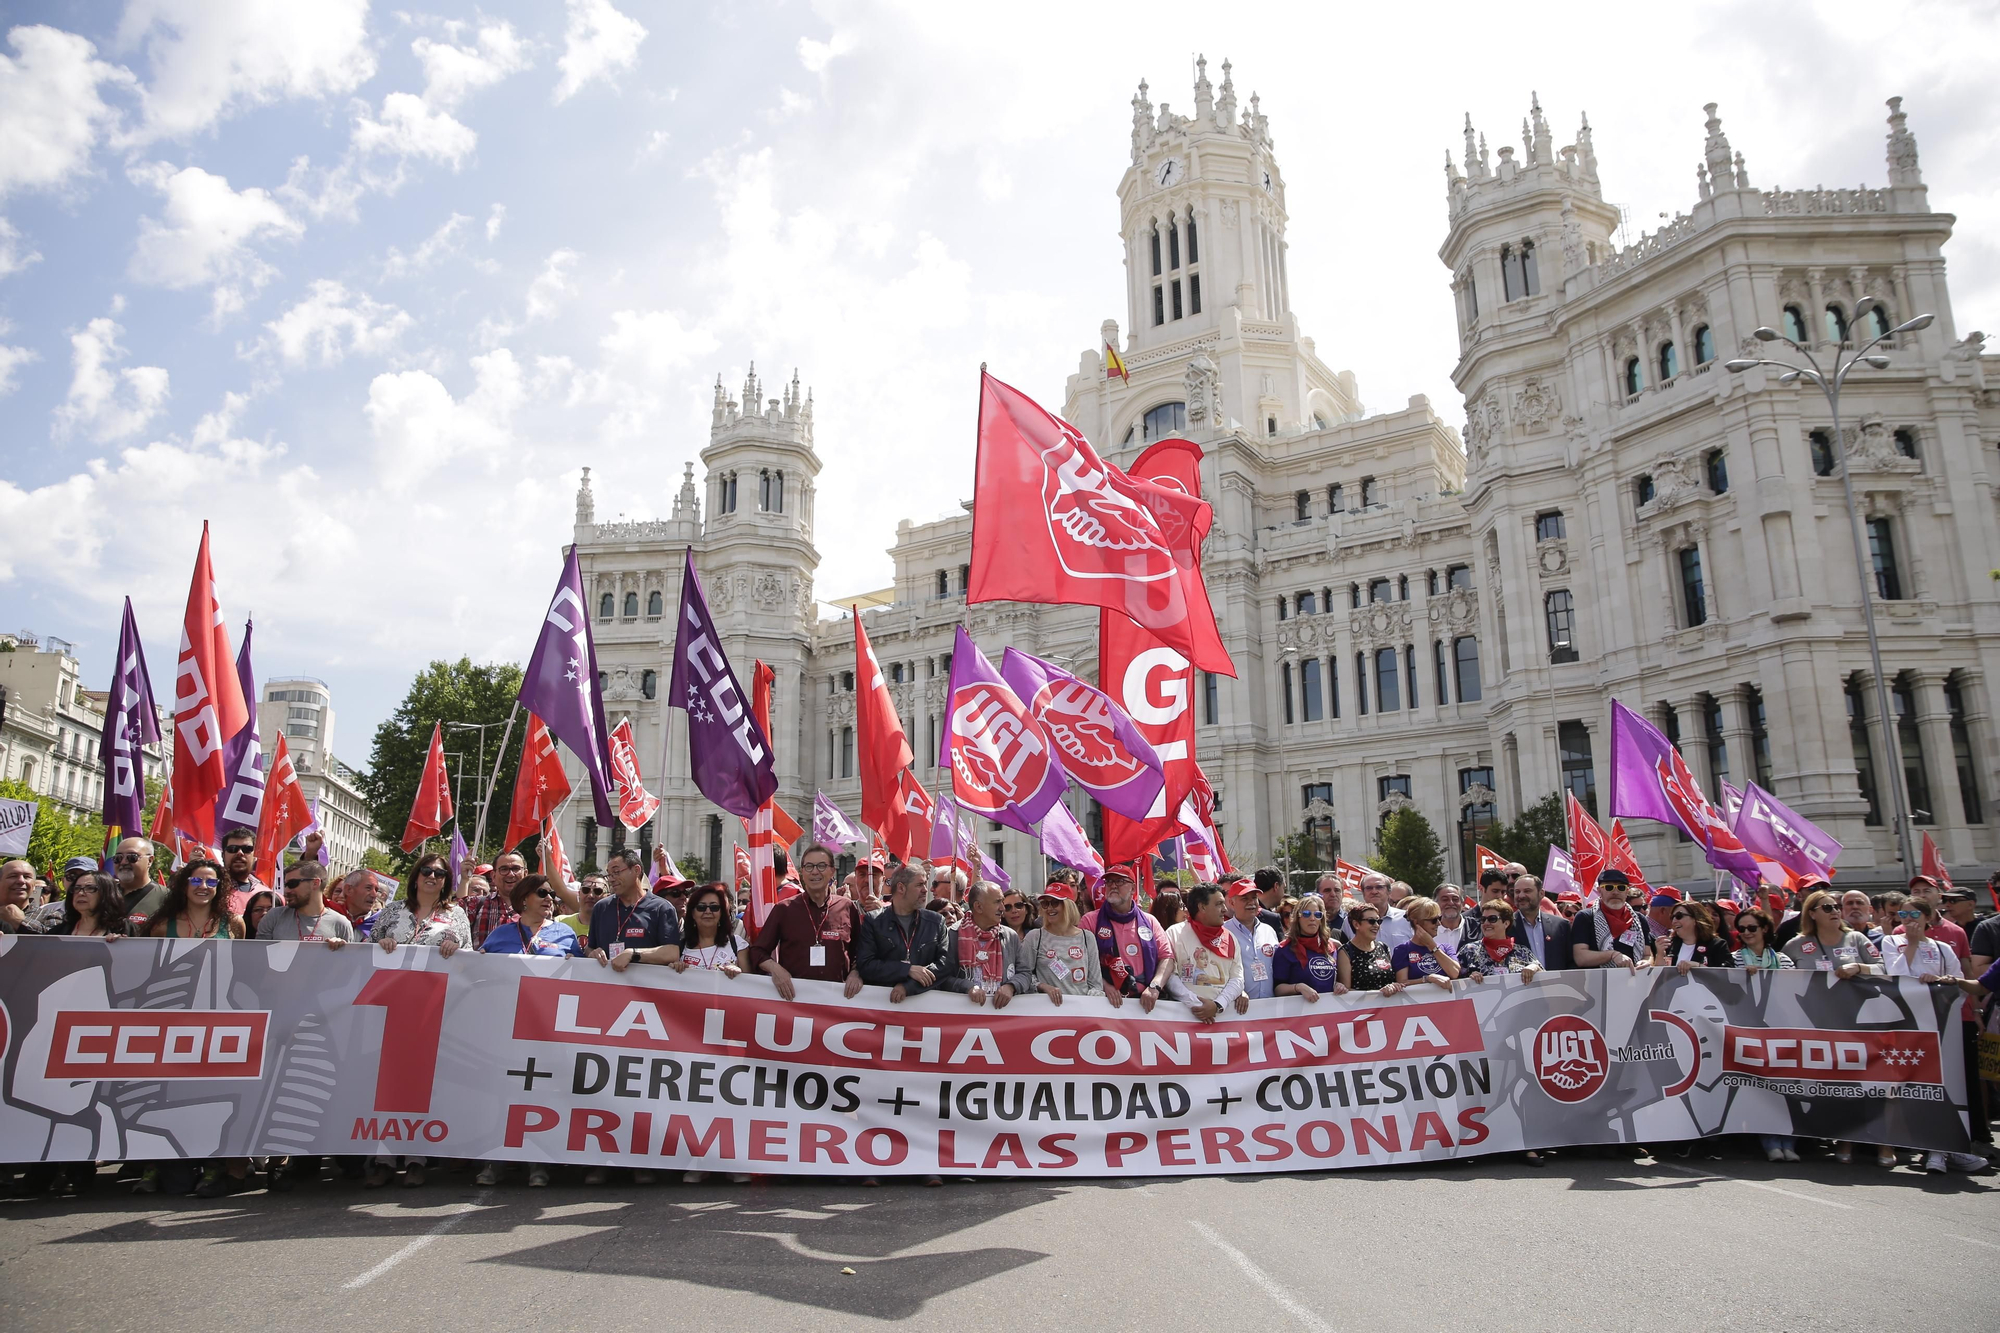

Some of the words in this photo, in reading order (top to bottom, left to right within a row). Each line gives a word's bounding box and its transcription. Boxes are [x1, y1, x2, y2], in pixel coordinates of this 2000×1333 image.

[951, 689, 1044, 790] UGT
[64, 1025, 253, 1064] CCOO
[351, 969, 449, 1114] 1
[554, 993, 670, 1041] LA
[702, 1009, 1004, 1065] LUCHA
[1029, 1012, 1450, 1067] CONTINÚA
[1540, 1029, 1596, 1064] UGT
[1617, 1043, 1675, 1063] Madrid
[1733, 1036, 1867, 1071] CCOO
[572, 1052, 861, 1113] DERECHOS
[938, 1080, 1191, 1121] IGUALDAD
[1255, 1054, 1491, 1112] COHESIÓN
[1722, 1075, 1804, 1095] comisiones
[1808, 1082, 1865, 1098] obreras
[1867, 1085, 1886, 1098] de
[1889, 1085, 1944, 1101] Madrid
[350, 1117, 449, 1143] MAYO
[503, 1103, 909, 1167] PRIMERO
[937, 1129, 1079, 1169] LAS
[1104, 1105, 1491, 1168] PERSONAS
